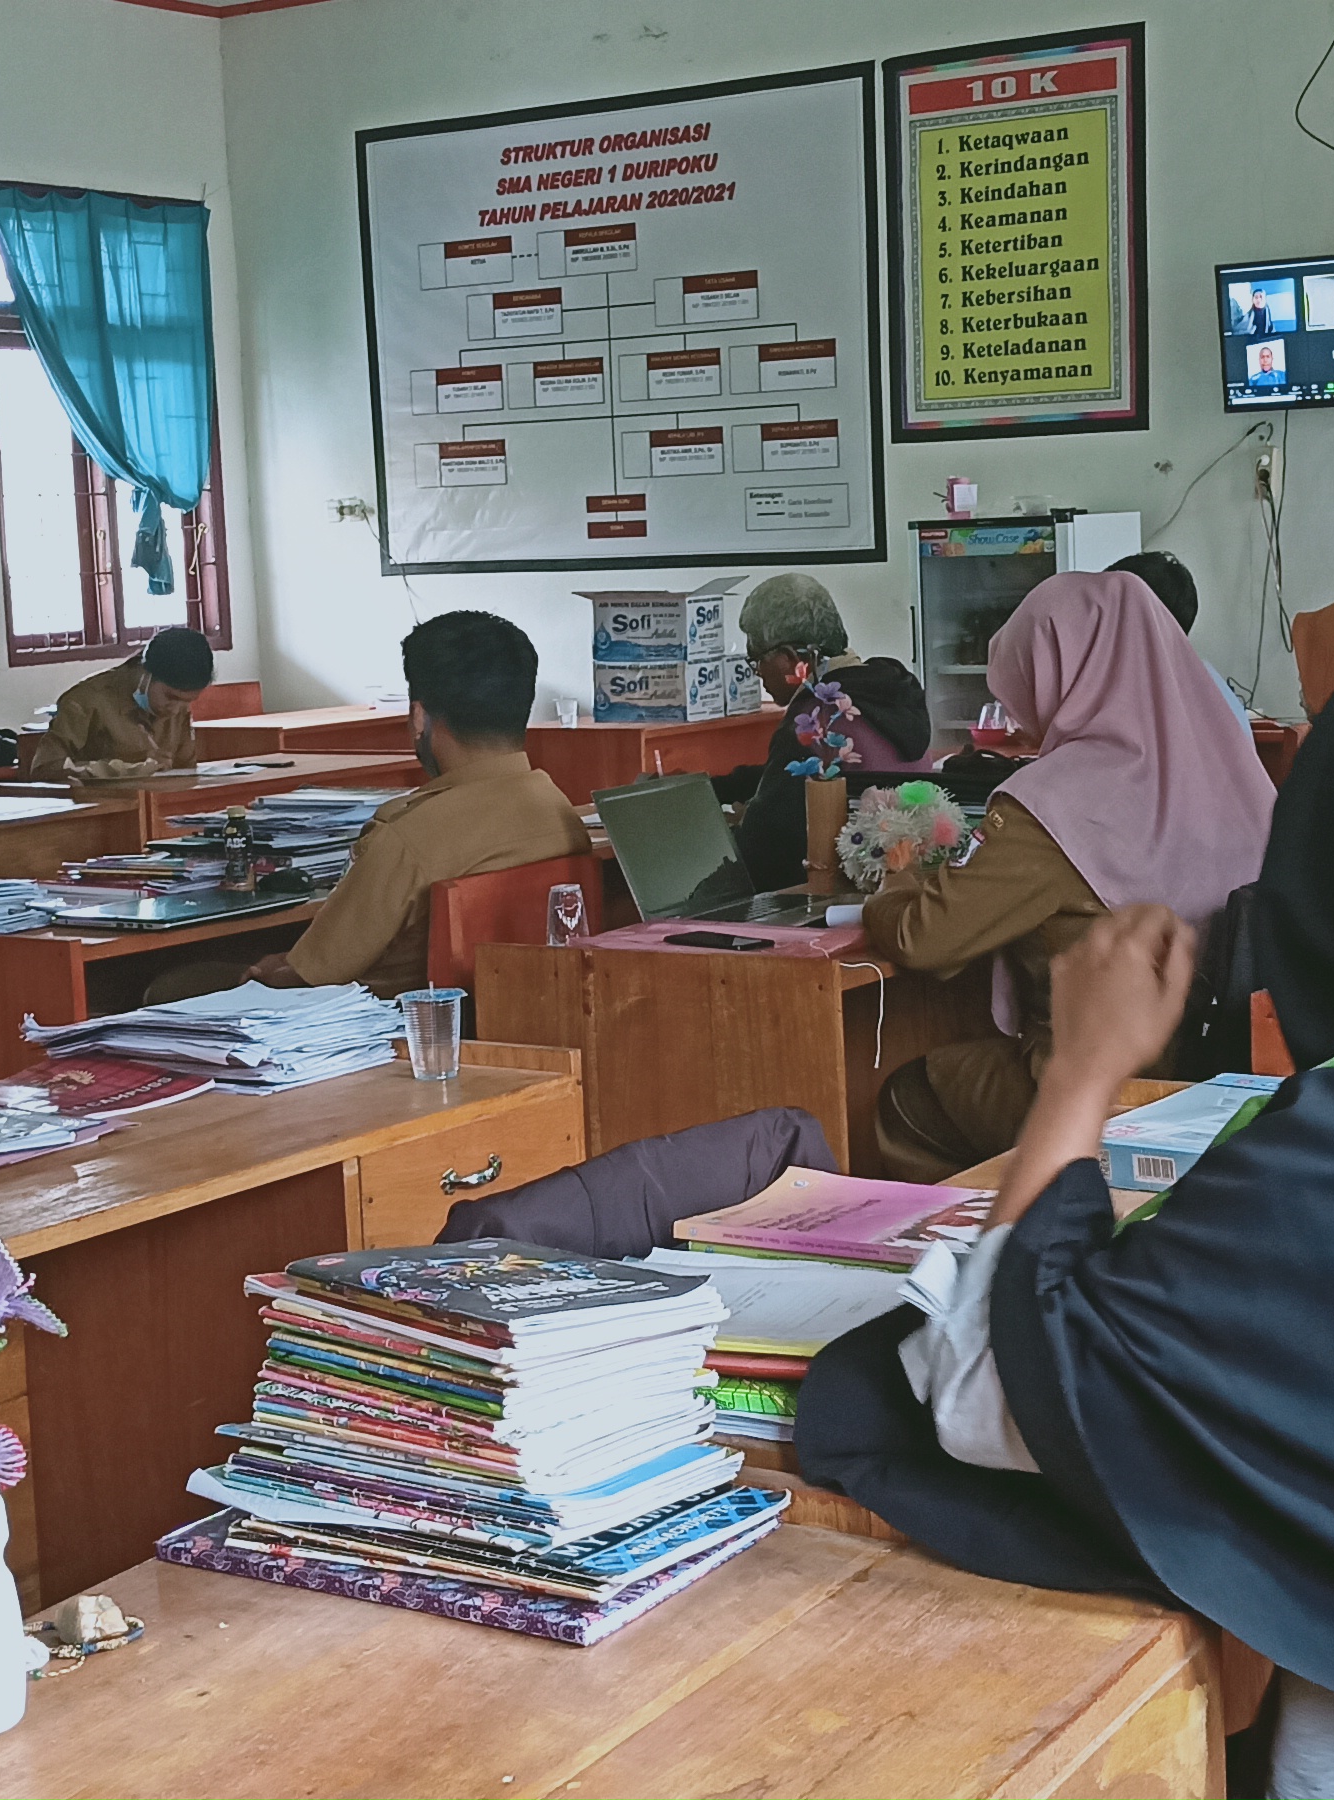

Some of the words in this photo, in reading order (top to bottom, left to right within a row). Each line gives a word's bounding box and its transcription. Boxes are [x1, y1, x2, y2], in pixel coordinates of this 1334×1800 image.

[967, 76, 1017, 102] 10
[1030, 70, 1059, 94] K
[500, 138, 593, 166] STRUKTUR
[599, 122, 710, 154] ORGANISASI
[937, 138, 950, 154] 1.
[958, 127, 1069, 153] Ketaqwaan
[497, 177, 532, 195] SMA
[537, 166, 603, 191] NEGERI
[607, 166, 616, 184] 1
[623, 154, 718, 182] DURIPOKU
[936, 165, 951, 180] 2.
[960, 152, 1089, 179] Kerindangan
[478, 204, 535, 227] TAHUN
[540, 192, 642, 222] PELAJARAN
[647, 182, 735, 210] 2020/2021
[938, 190, 952, 206] 3.
[960, 180, 1067, 205] Keindahan
[938, 216, 952, 232] 4.
[960, 207, 1068, 230] Keamanan
[938, 242, 952, 258] 5.
[960, 234, 1062, 256] Ketertiban
[938, 268, 952, 284] 6.
[961, 257, 1099, 282] Kekeluargaan
[940, 294, 952, 309] 7.
[961, 285, 1071, 307] Kebersihan
[939, 319, 954, 334] 8.
[962, 311, 1088, 333] Keterbukaan
[940, 345, 954, 360] 9.
[963, 337, 1087, 359] Keteladanan
[934, 370, 956, 386] 10.
[963, 363, 1093, 386] Kenyamanan
[612, 613, 651, 632] Sofi
[696, 605, 719, 625] Sofi
[610, 676, 649, 696] Sofi
[698, 665, 720, 685] Sofi
[227, 837, 246, 849] ABC
[551, 1536, 609, 1558] MY
